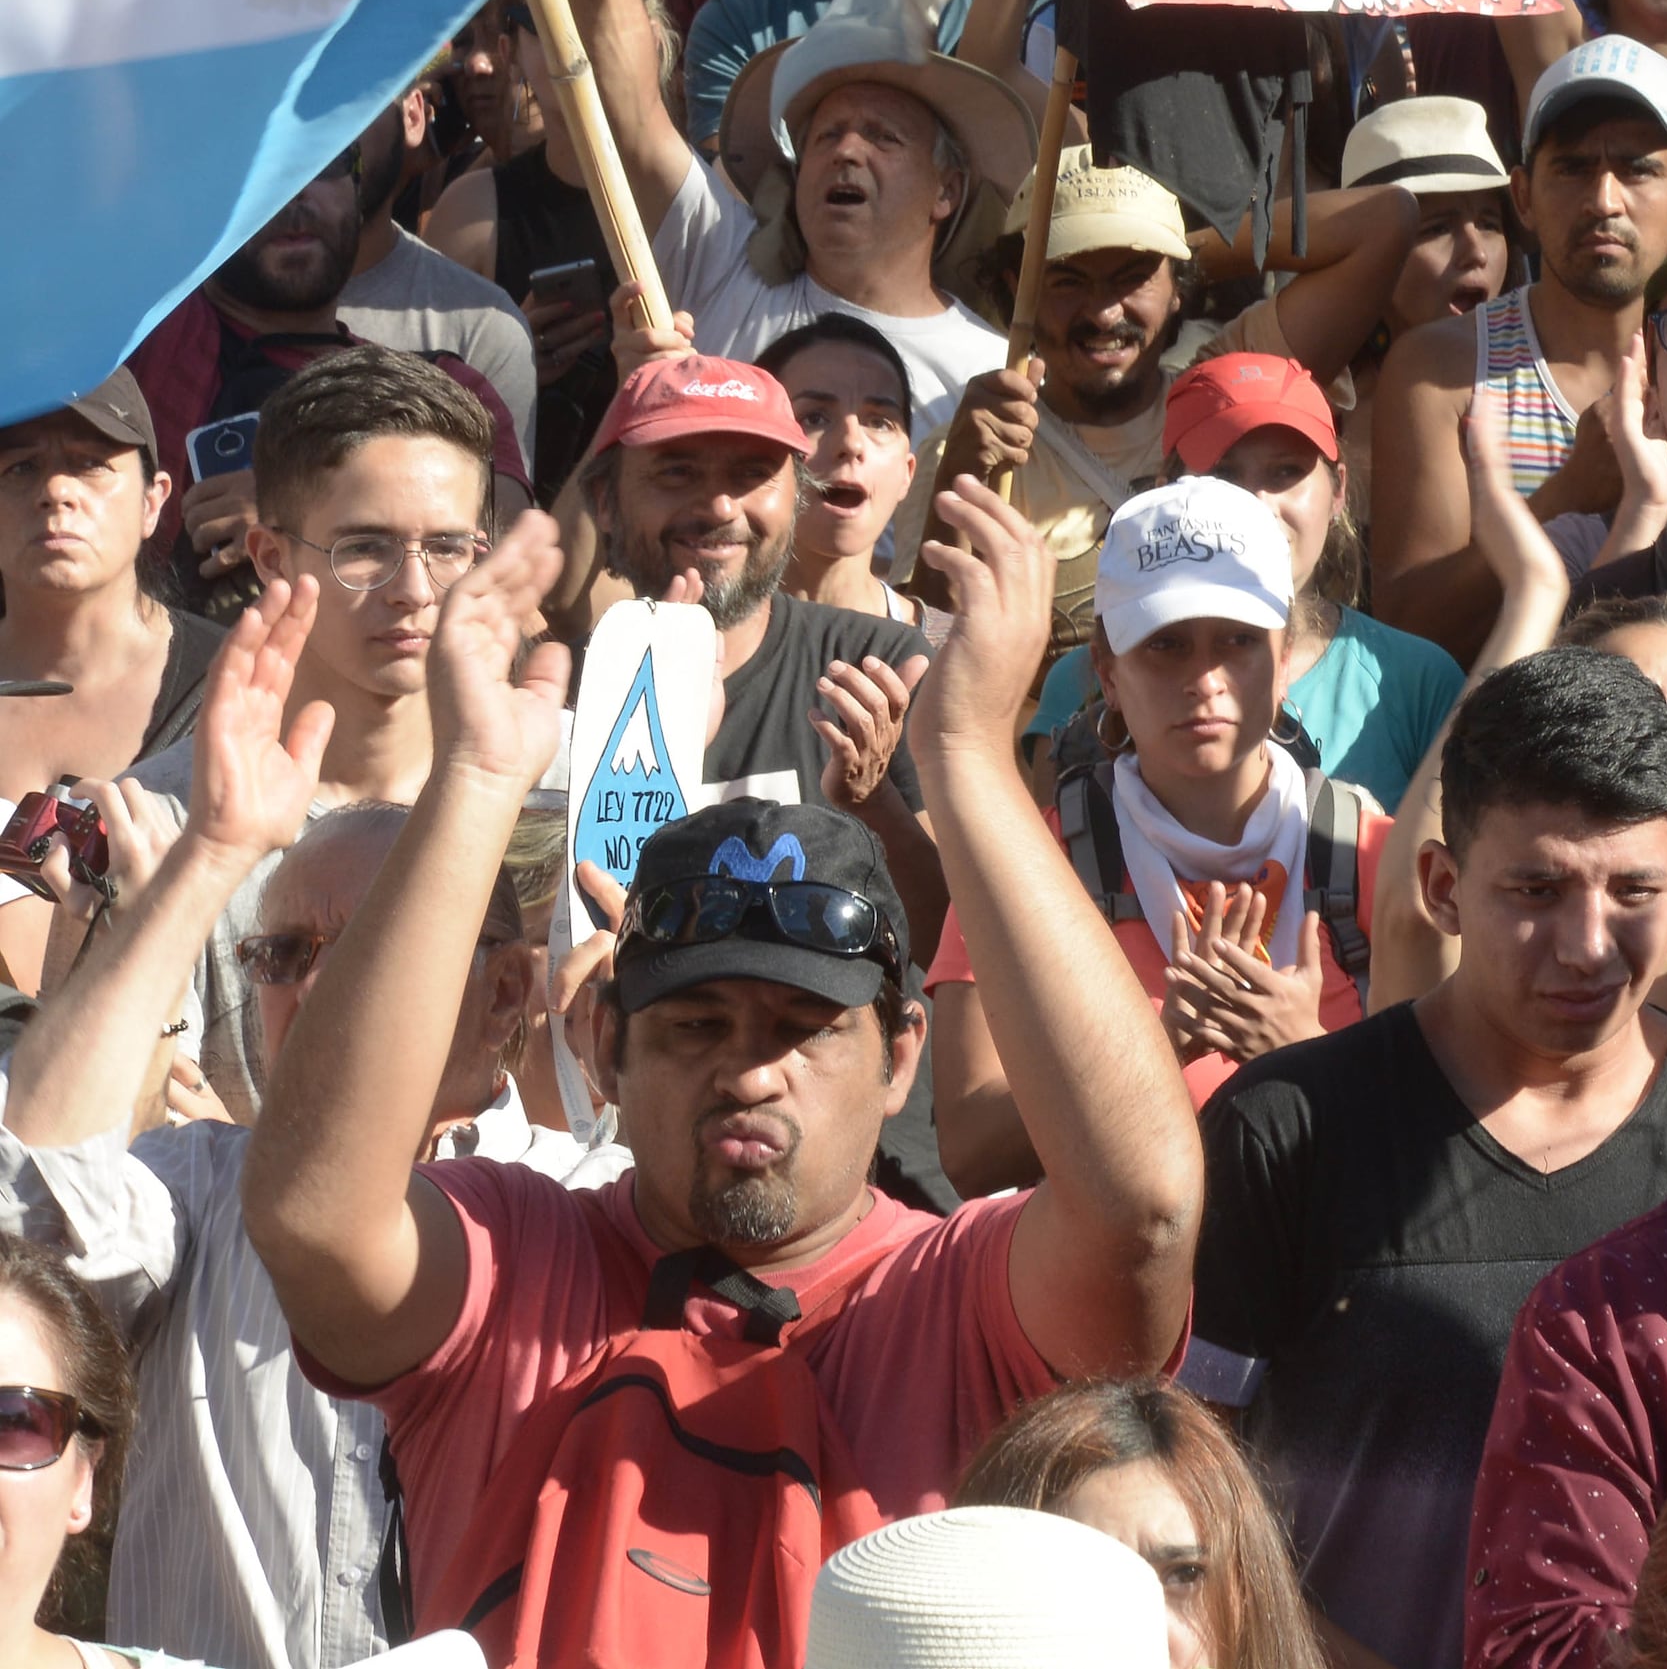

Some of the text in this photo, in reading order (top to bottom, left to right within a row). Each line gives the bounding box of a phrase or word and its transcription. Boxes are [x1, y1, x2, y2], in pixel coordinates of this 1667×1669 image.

[1147, 517, 1225, 542] FANTASTIC
[1138, 530, 1246, 573] BEASTS
[596, 790, 676, 823] LEY 7722
[604, 837, 630, 871] NO
